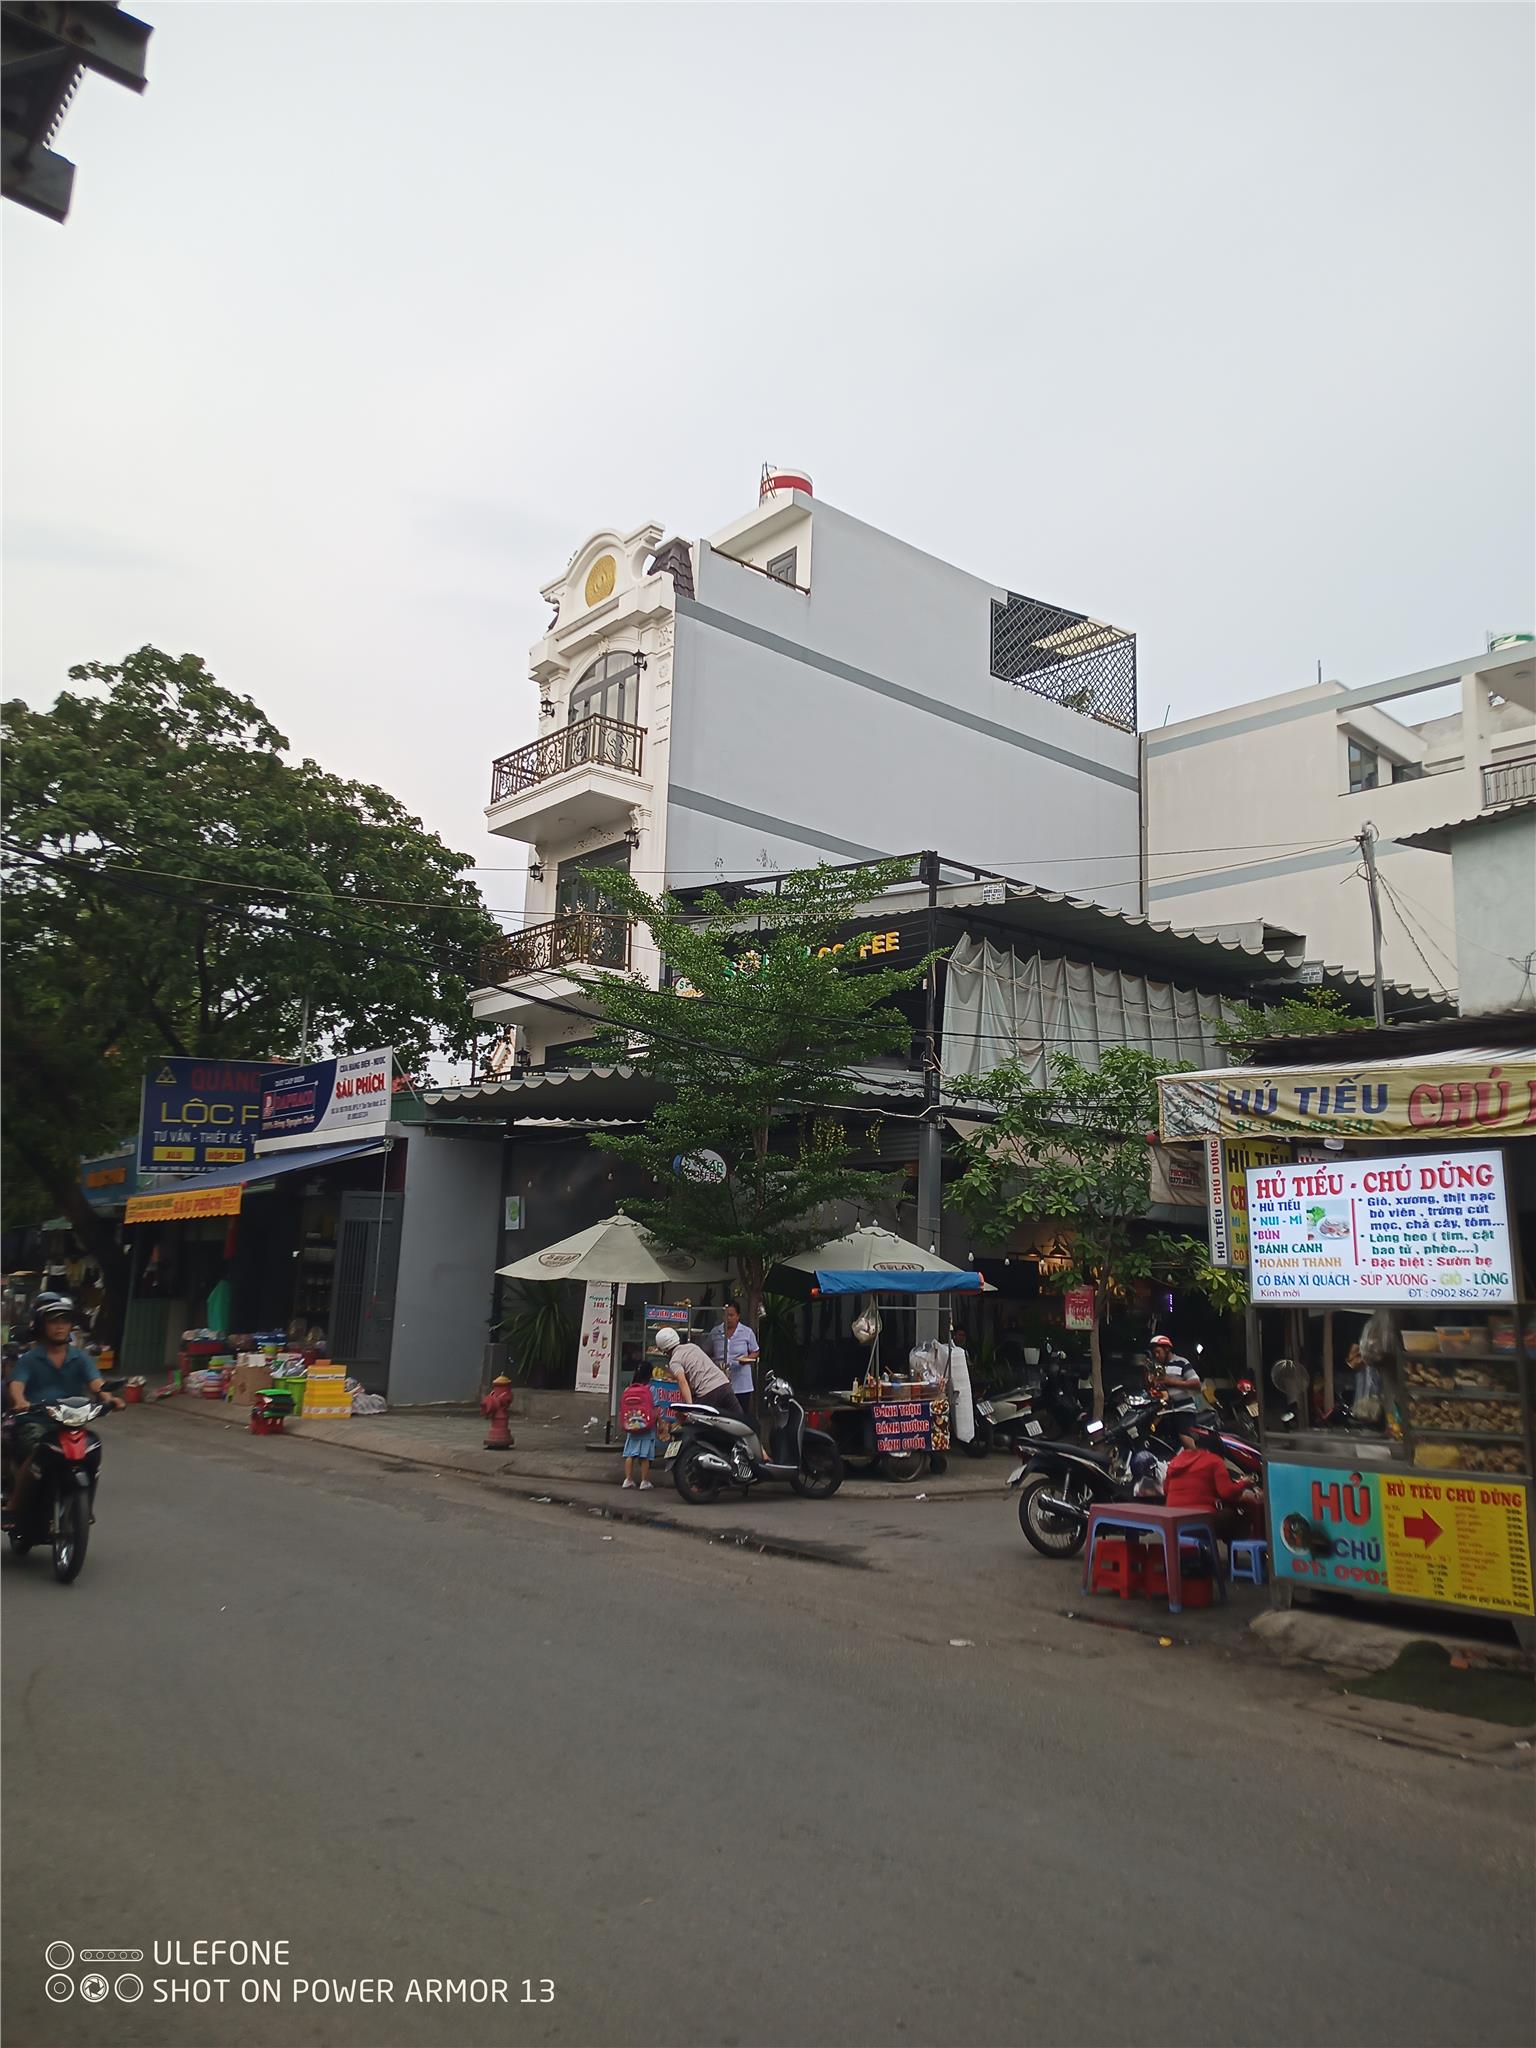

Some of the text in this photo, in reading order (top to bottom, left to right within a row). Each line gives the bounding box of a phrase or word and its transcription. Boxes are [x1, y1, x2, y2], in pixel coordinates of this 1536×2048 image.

[1227, 1073, 1388, 1115] HỦ TIẾU
[1409, 1067, 1511, 1129] CHÚ
[161, 1097, 234, 1128] LỘC
[1256, 1160, 1495, 1199] HỦ TIẾU CHÚ DŨNG
[1443, 1193, 1466, 1204] thịt
[1470, 1192, 1496, 1203] nạc
[1277, 1198, 1301, 1211] TIẾU
[1389, 1208, 1416, 1217] viên
[1260, 1216, 1280, 1226] NUI
[1258, 1228, 1280, 1240] BÚN
[1369, 1233, 1399, 1243] Lòng
[1403, 1232, 1427, 1242] heo
[1258, 1243, 1323, 1254] BÁNH CANH
[1371, 1246, 1395, 1255] bao
[1399, 1257, 1425, 1268] biệt
[1257, 1272, 1271, 1286] CÓ
[1274, 1272, 1296, 1286] BÁN
[1312, 1271, 1350, 1287] QUÁCH
[1386, 1273, 1428, 1286] XƯƠNG
[1474, 1269, 1509, 1285] LÒNG
[1430, 1288, 1456, 1298] 0902
[1459, 1288, 1479, 1298] 862
[1483, 1288, 1502, 1297] 747
[876, 1421, 900, 1435] BÁNH
[1311, 1472, 1371, 1527] HỦ
